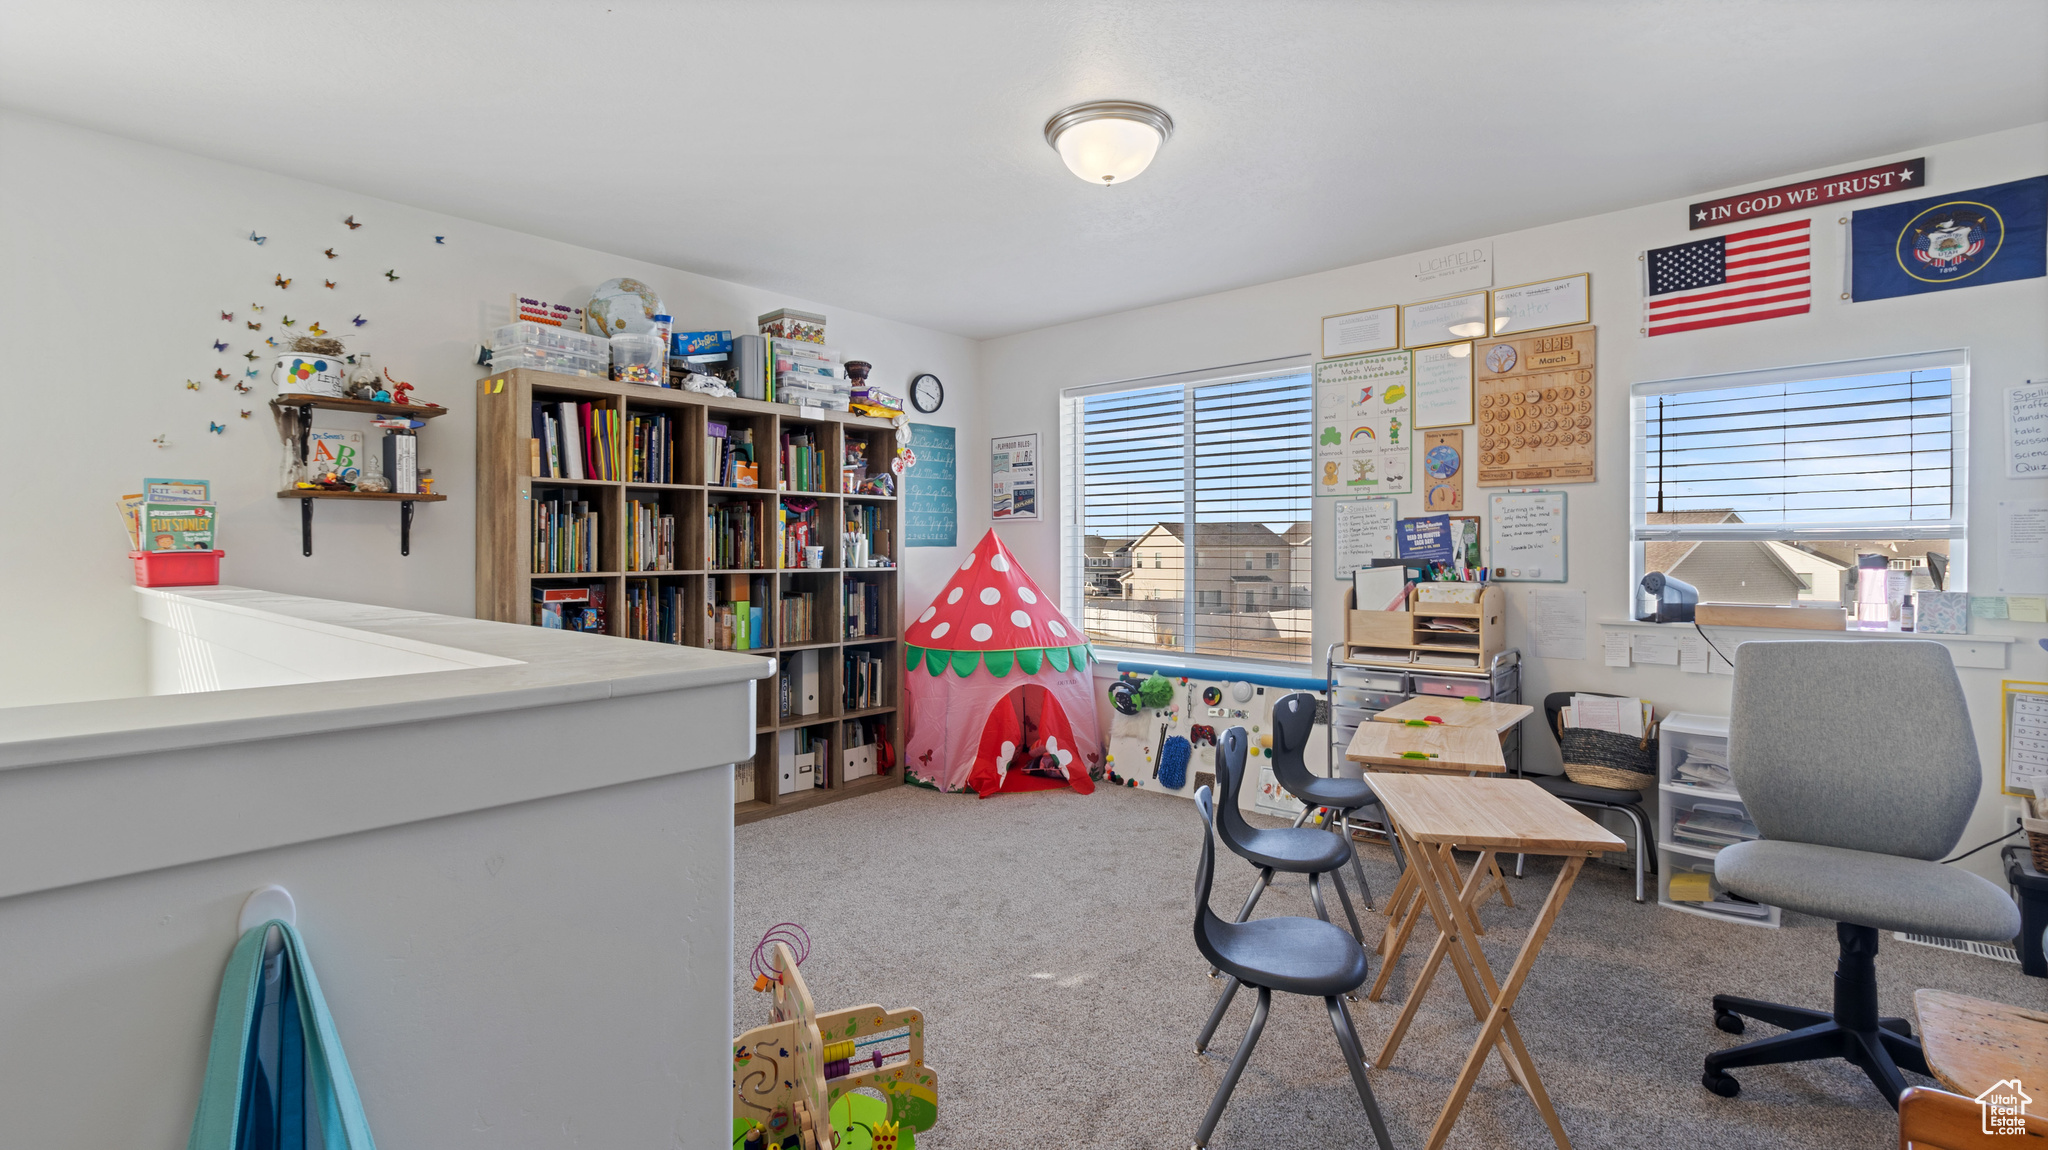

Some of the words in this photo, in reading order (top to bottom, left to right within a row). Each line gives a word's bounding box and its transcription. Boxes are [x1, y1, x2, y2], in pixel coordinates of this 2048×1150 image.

[1710, 204, 1732, 220] IN
[1737, 194, 1782, 215] GOD
[1786, 186, 1818, 204] WE
[1824, 171, 1895, 198] TRUST
[1418, 248, 1482, 274] LICHFIELD
[1496, 292, 1522, 300] SCIENCE
[1554, 282, 1570, 290] UNIT
[1419, 302, 1451, 312] CHARACTER
[1452, 298, 1468, 308] TRAIT
[1506, 302, 1551, 318] Matter
[692, 332, 718, 350] Zingo!
[1539, 356, 1566, 364] March
[2013, 400, 2048, 415] giraffe
[2014, 426, 2042, 435] table
[313, 440, 335, 462] A
[334, 444, 356, 467] B
[1012, 450, 1032, 462] SHARE
[341, 467, 360, 481] C
[2016, 462, 2048, 473] Quiz
[1015, 498, 1034, 508] EXPLORE
[151, 519, 171, 533] FLAT
[171, 518, 211, 532] STANLEY
